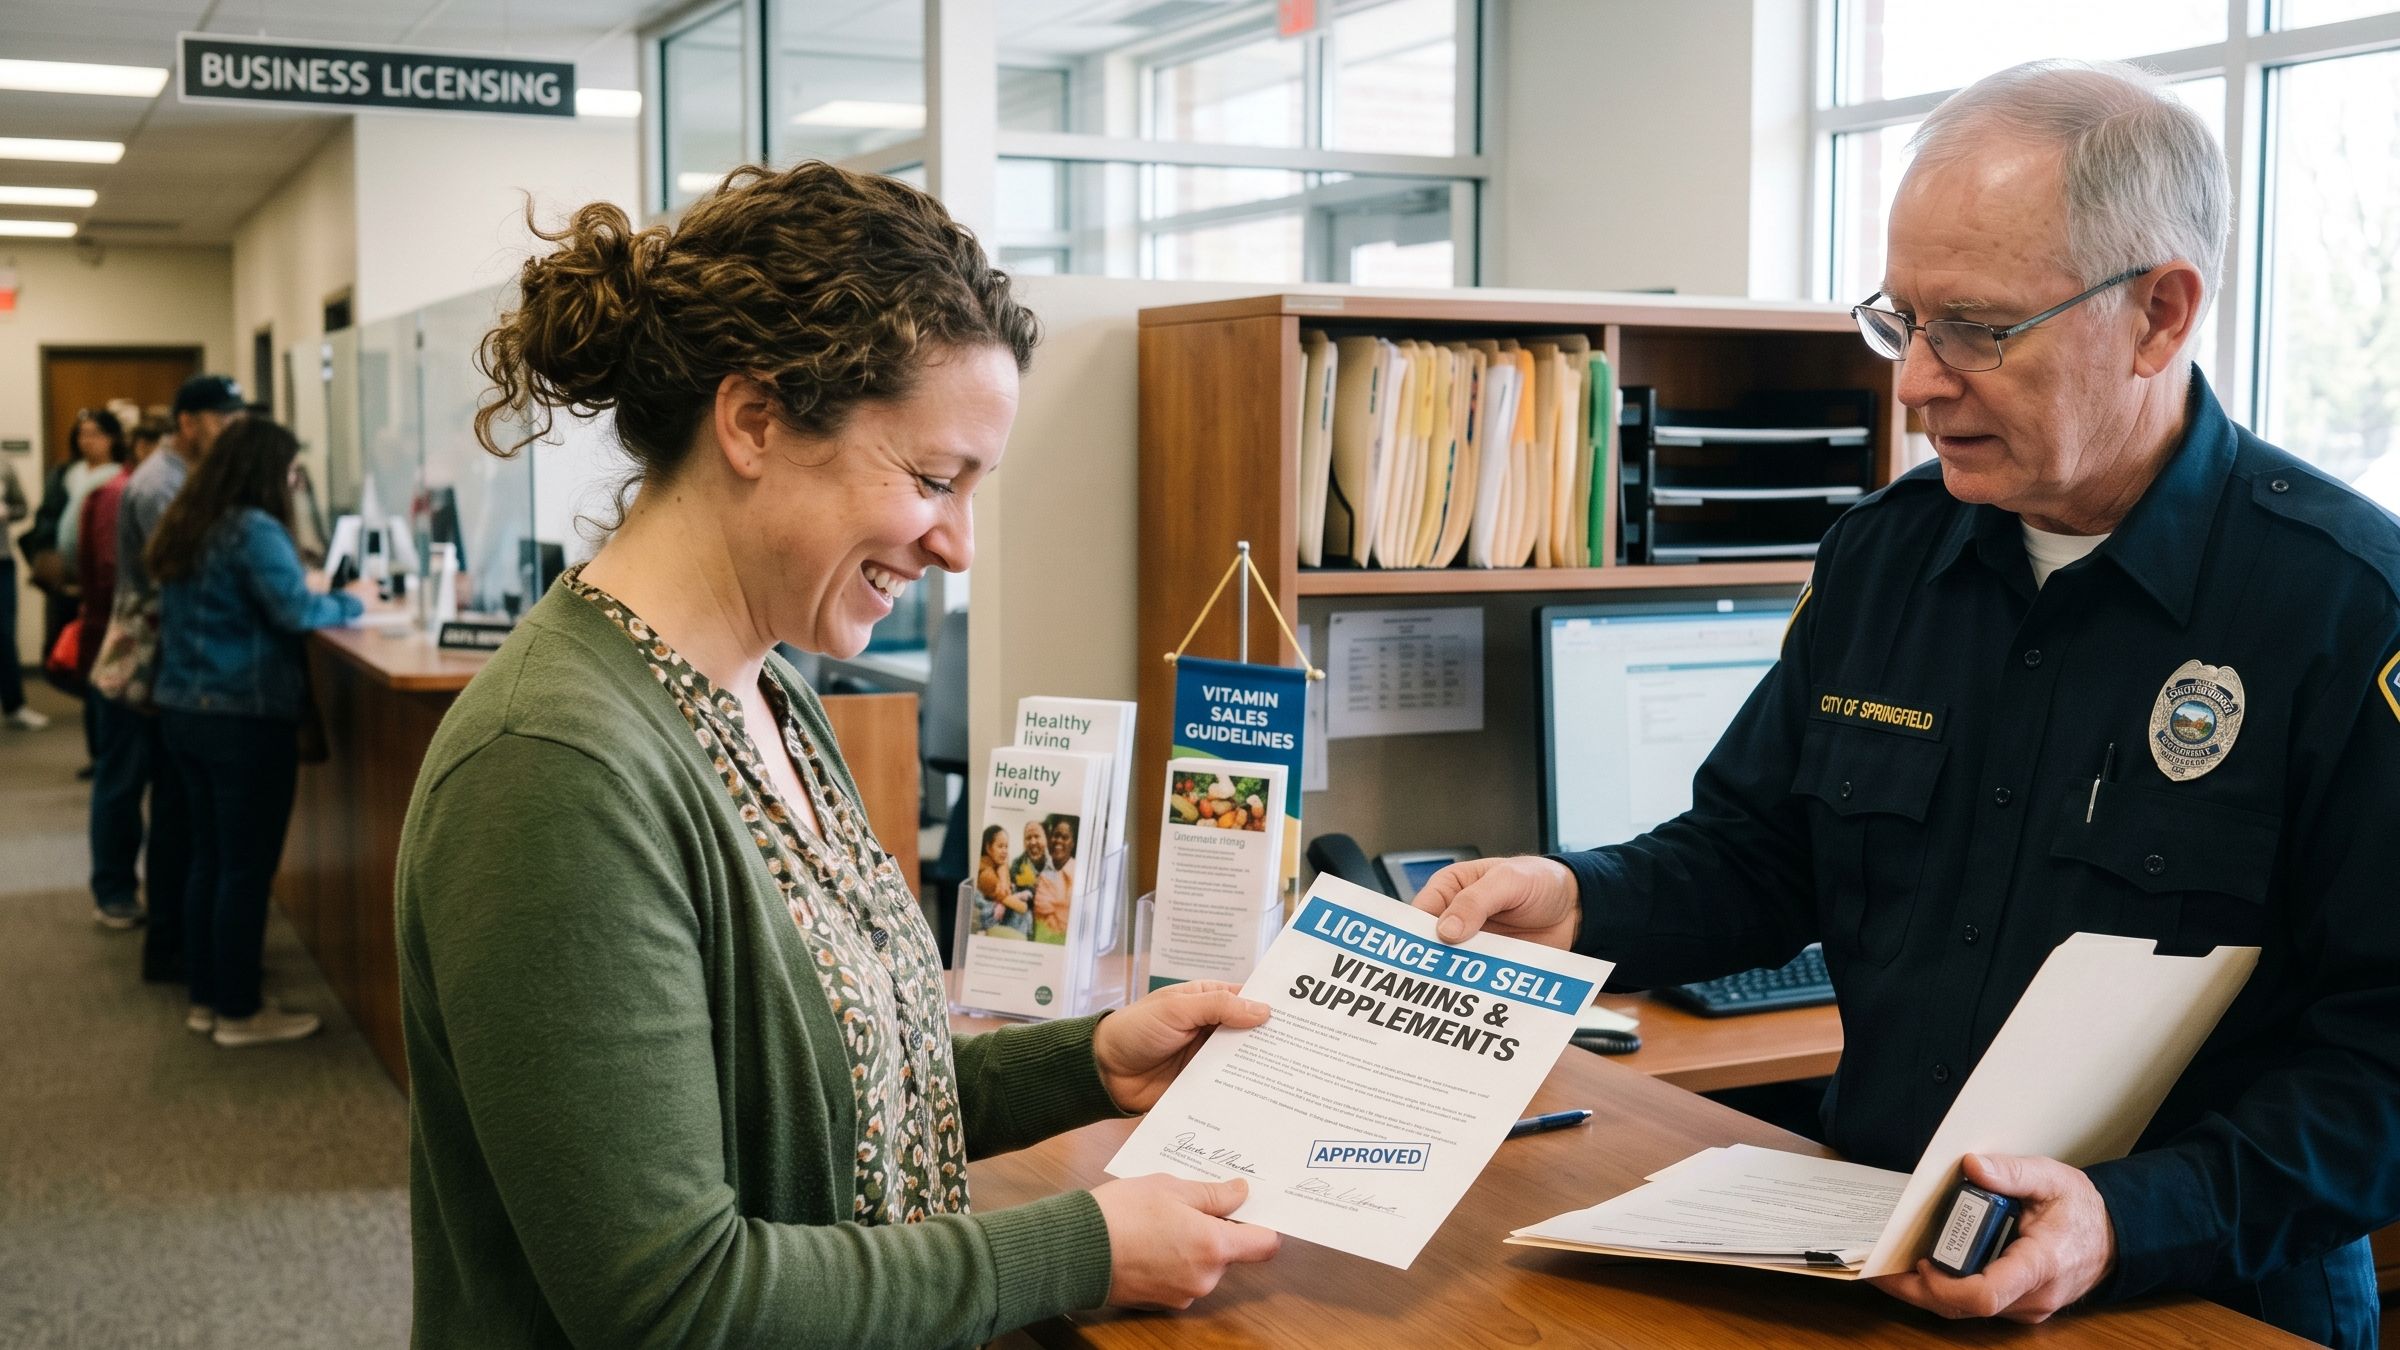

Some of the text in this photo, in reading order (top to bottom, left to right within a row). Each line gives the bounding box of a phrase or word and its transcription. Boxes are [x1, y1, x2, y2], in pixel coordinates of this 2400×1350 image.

[201, 53, 562, 107] BUSINESS LICENSING
[1202, 685, 1279, 709] VITAMIN
[1025, 711, 1092, 735] Healthy
[1210, 705, 1269, 727] SALES
[1821, 695, 1933, 730] CITY OF SPRINGFIELD
[1185, 722, 1295, 750] GUIDELINES
[995, 762, 1061, 787] Healthy
[993, 781, 1040, 805] living
[1314, 908, 1563, 1006] LICENCE TO SELL
[1330, 953, 1510, 1029] VITAMINS &
[1289, 974, 1520, 1062] SUPPLEMENTS
[1314, 1147, 1422, 1165] APPROVED
